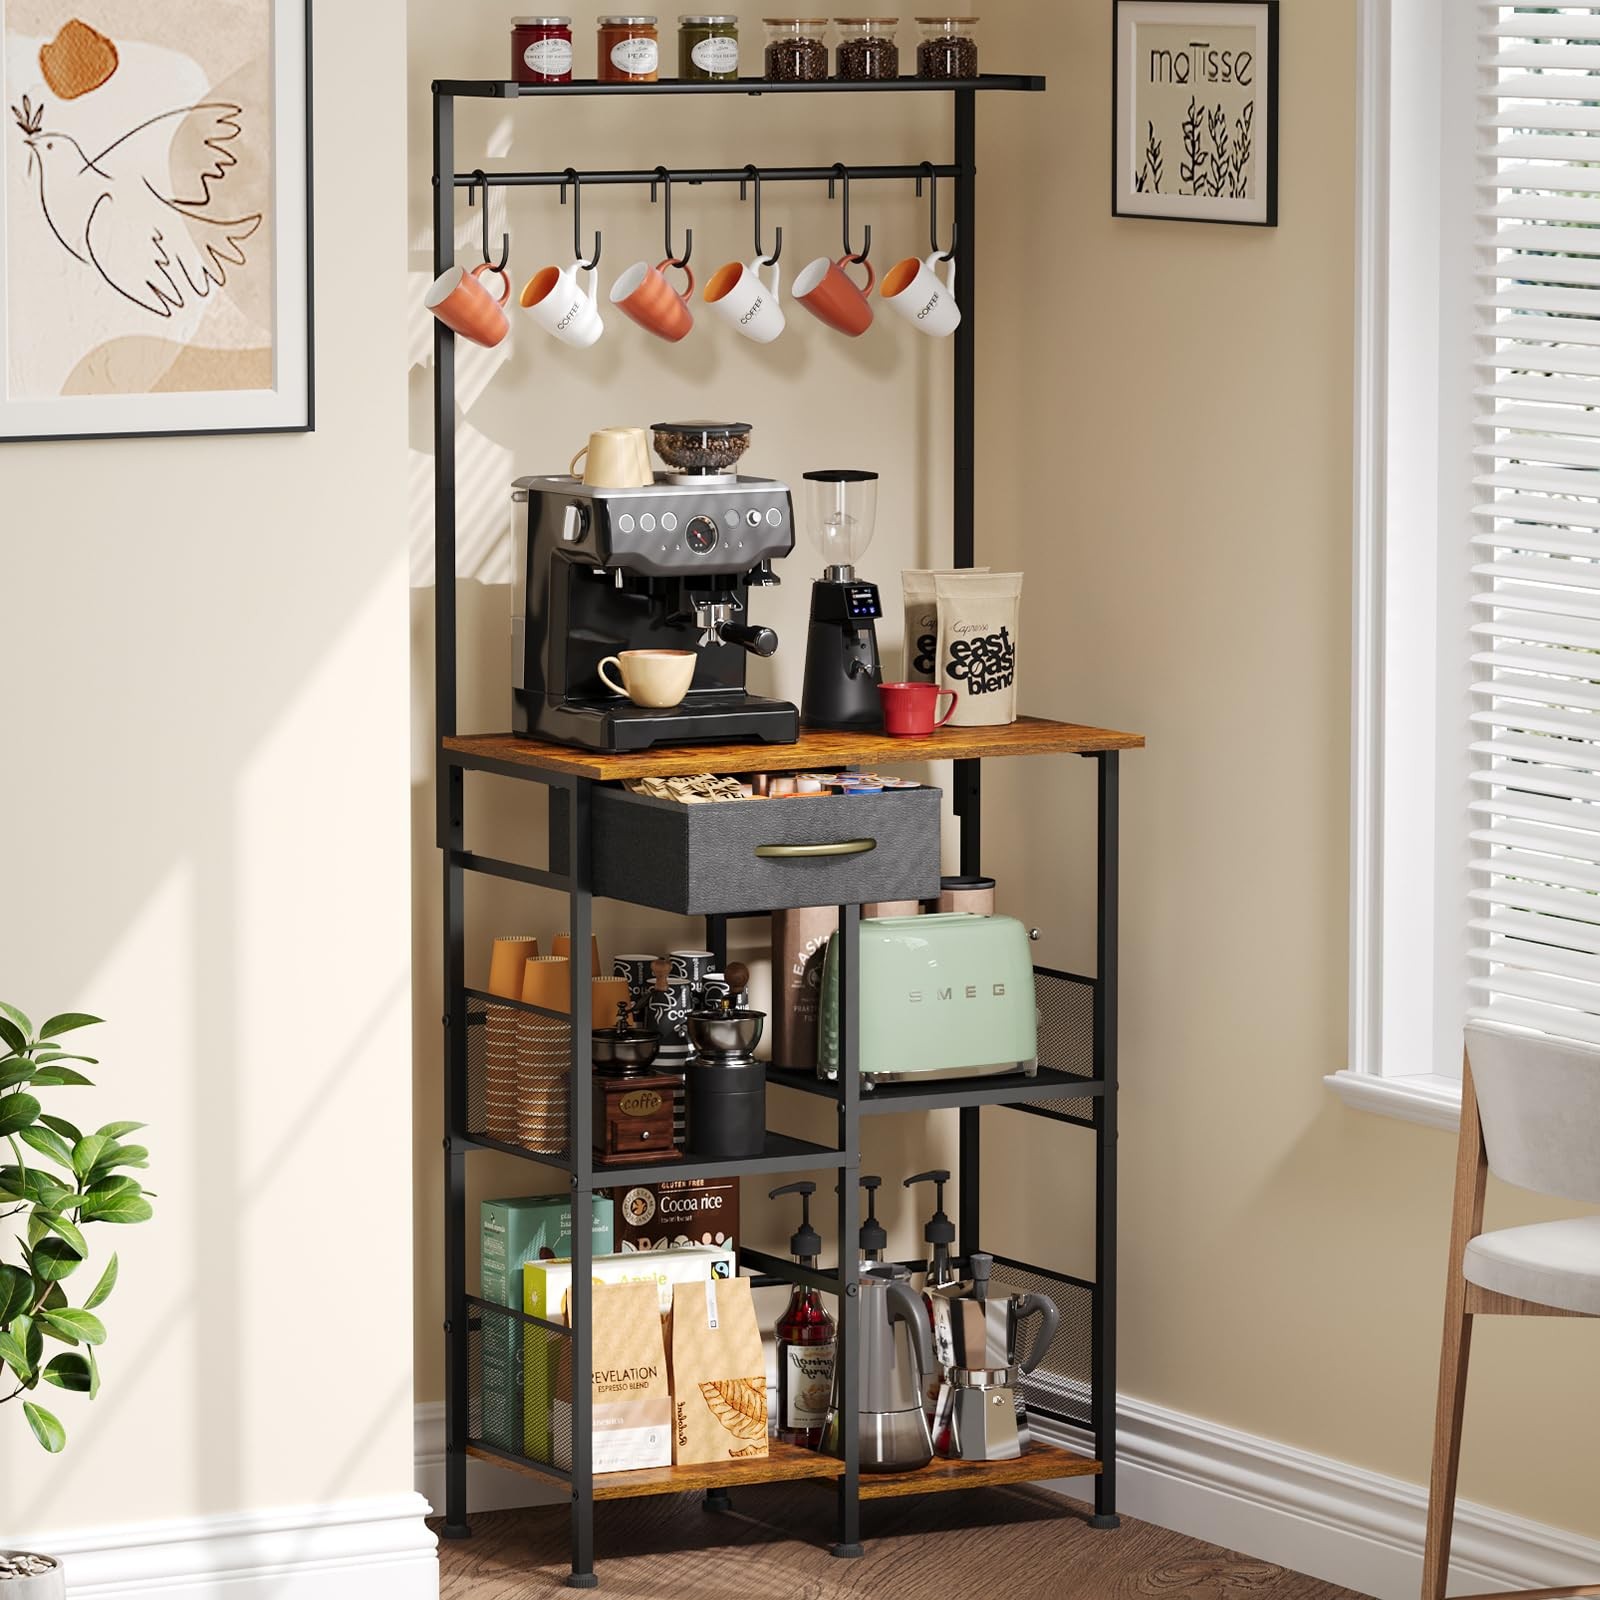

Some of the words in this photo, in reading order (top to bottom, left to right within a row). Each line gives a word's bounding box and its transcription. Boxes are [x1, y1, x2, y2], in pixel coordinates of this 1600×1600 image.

[557, 302, 580, 330] COFFEE
[741, 296, 763, 324] COFFEE
[917, 291, 939, 319] COFFEE
[950, 626, 1014, 660] east
[908, 984, 1005, 1003] SMEG
[661, 1181, 687, 1189] GLUTEN
[689, 1179, 705, 1187] FREE
[660, 1196, 698, 1213] Cocoa
[701, 1193, 723, 1209] rice
[598, 1383, 628, 1393] ESPRESSO
[629, 1381, 649, 1390] BLEND
